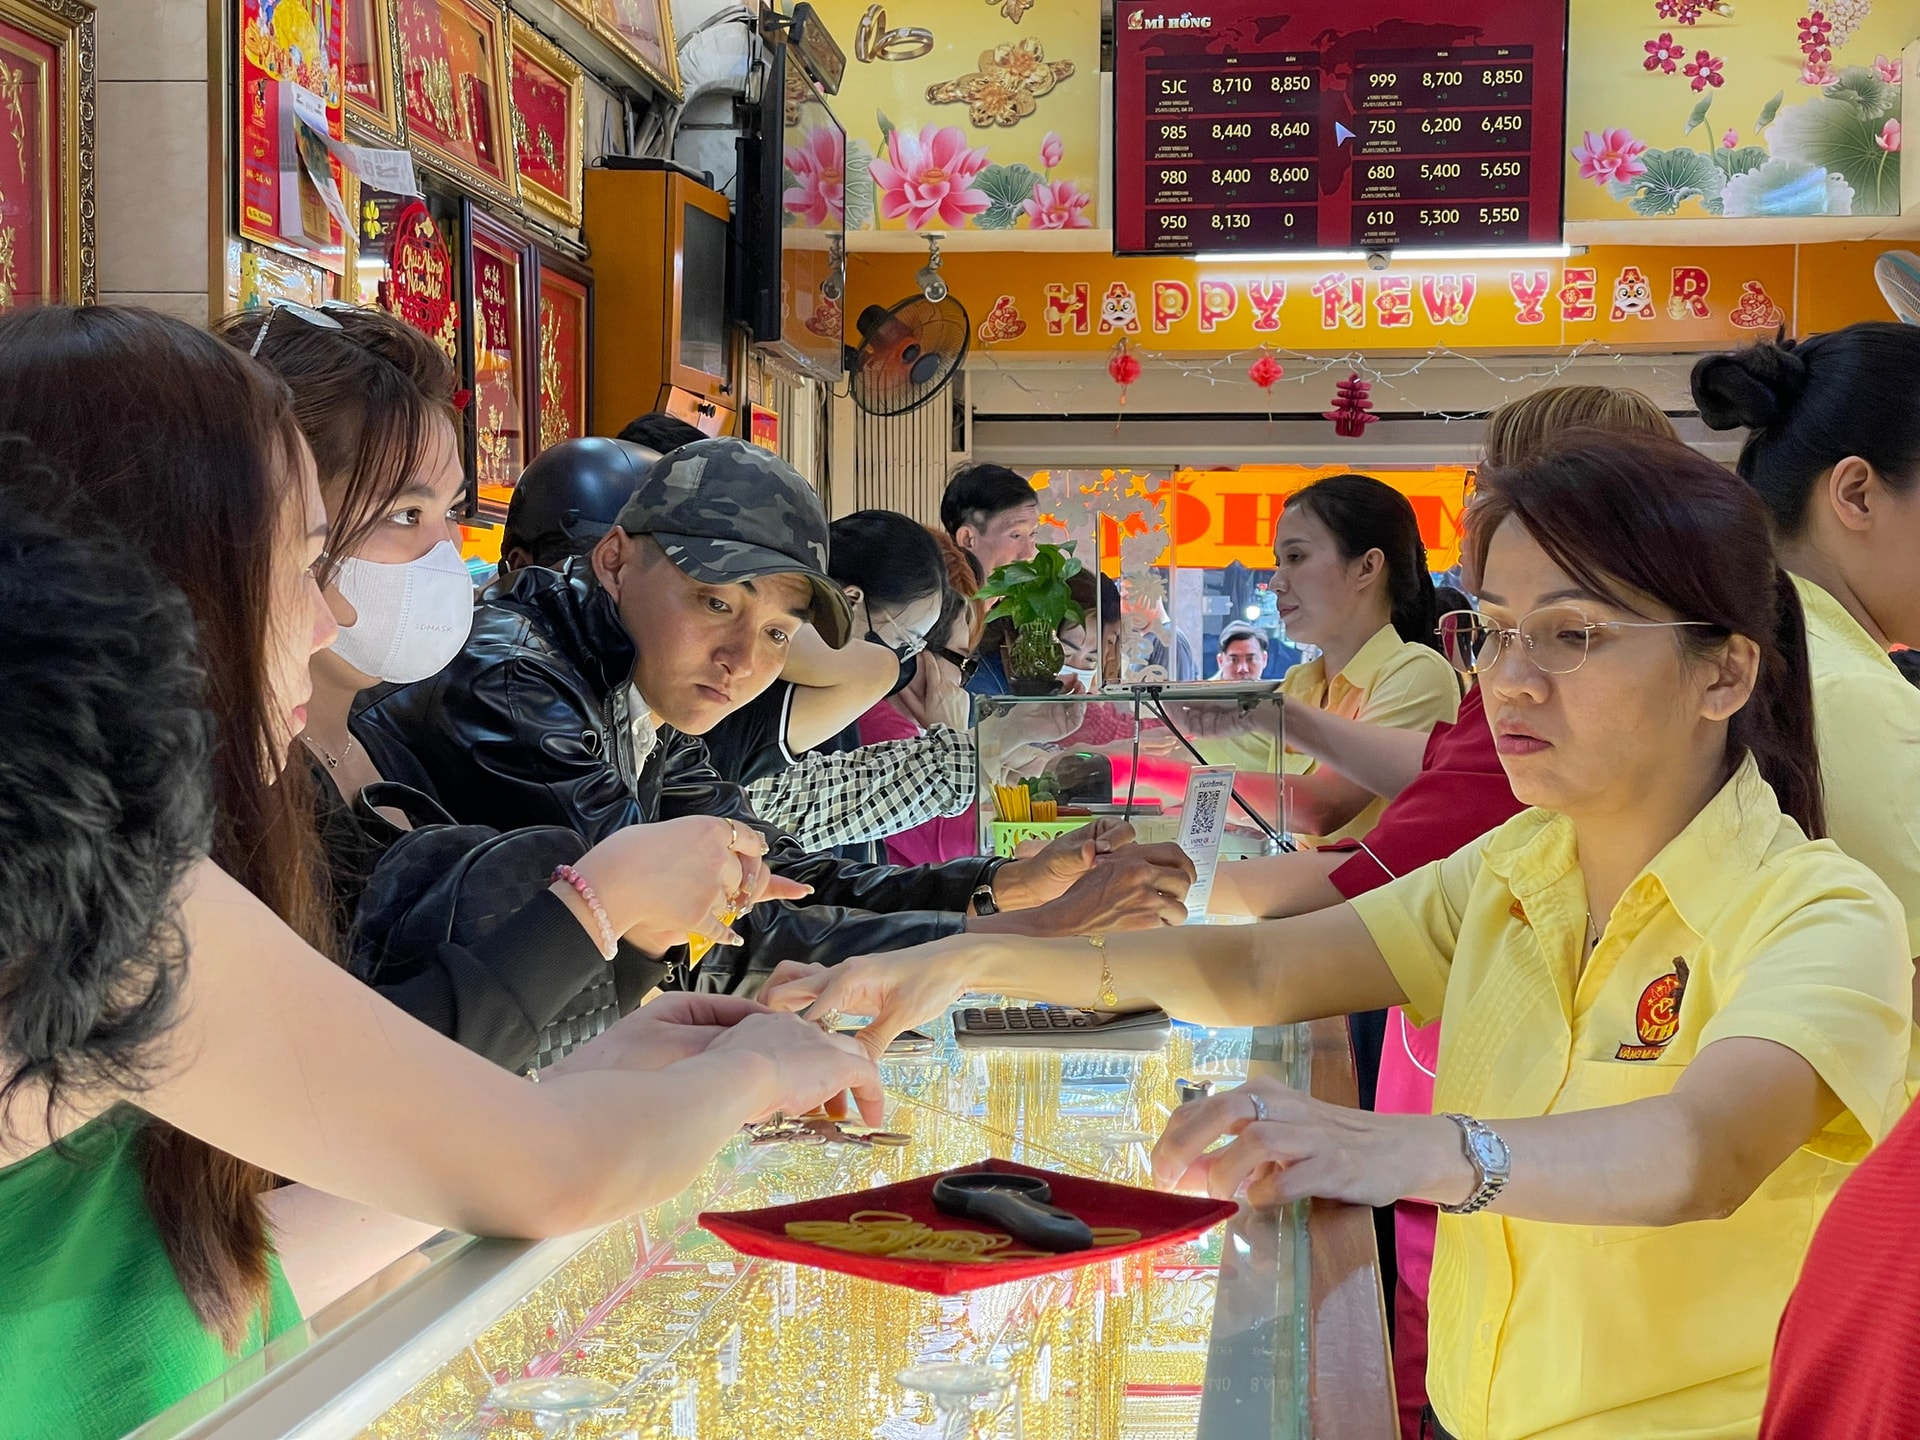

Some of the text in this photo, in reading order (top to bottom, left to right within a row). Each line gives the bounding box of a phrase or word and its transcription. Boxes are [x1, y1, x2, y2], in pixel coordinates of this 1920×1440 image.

[1162, 76, 1311, 95] SJC 8,710 8,850
[1370, 70, 1523, 89] 999 8,700 8,850
[1160, 122, 1310, 140] 985 8,440 8,640
[1369, 116, 1522, 135] 750 6,200 6,450
[1160, 167, 1309, 185] 980 8,400 8,600
[1367, 162, 1521, 181] 680 5,400 5,650
[1160, 213, 1294, 230] 950 8,130 0
[1366, 207, 1520, 227] 610 5,300 5,550
[1044, 265, 1712, 336] HAPPY NEW YEAR
[1640, 1019, 1679, 1041] MH
